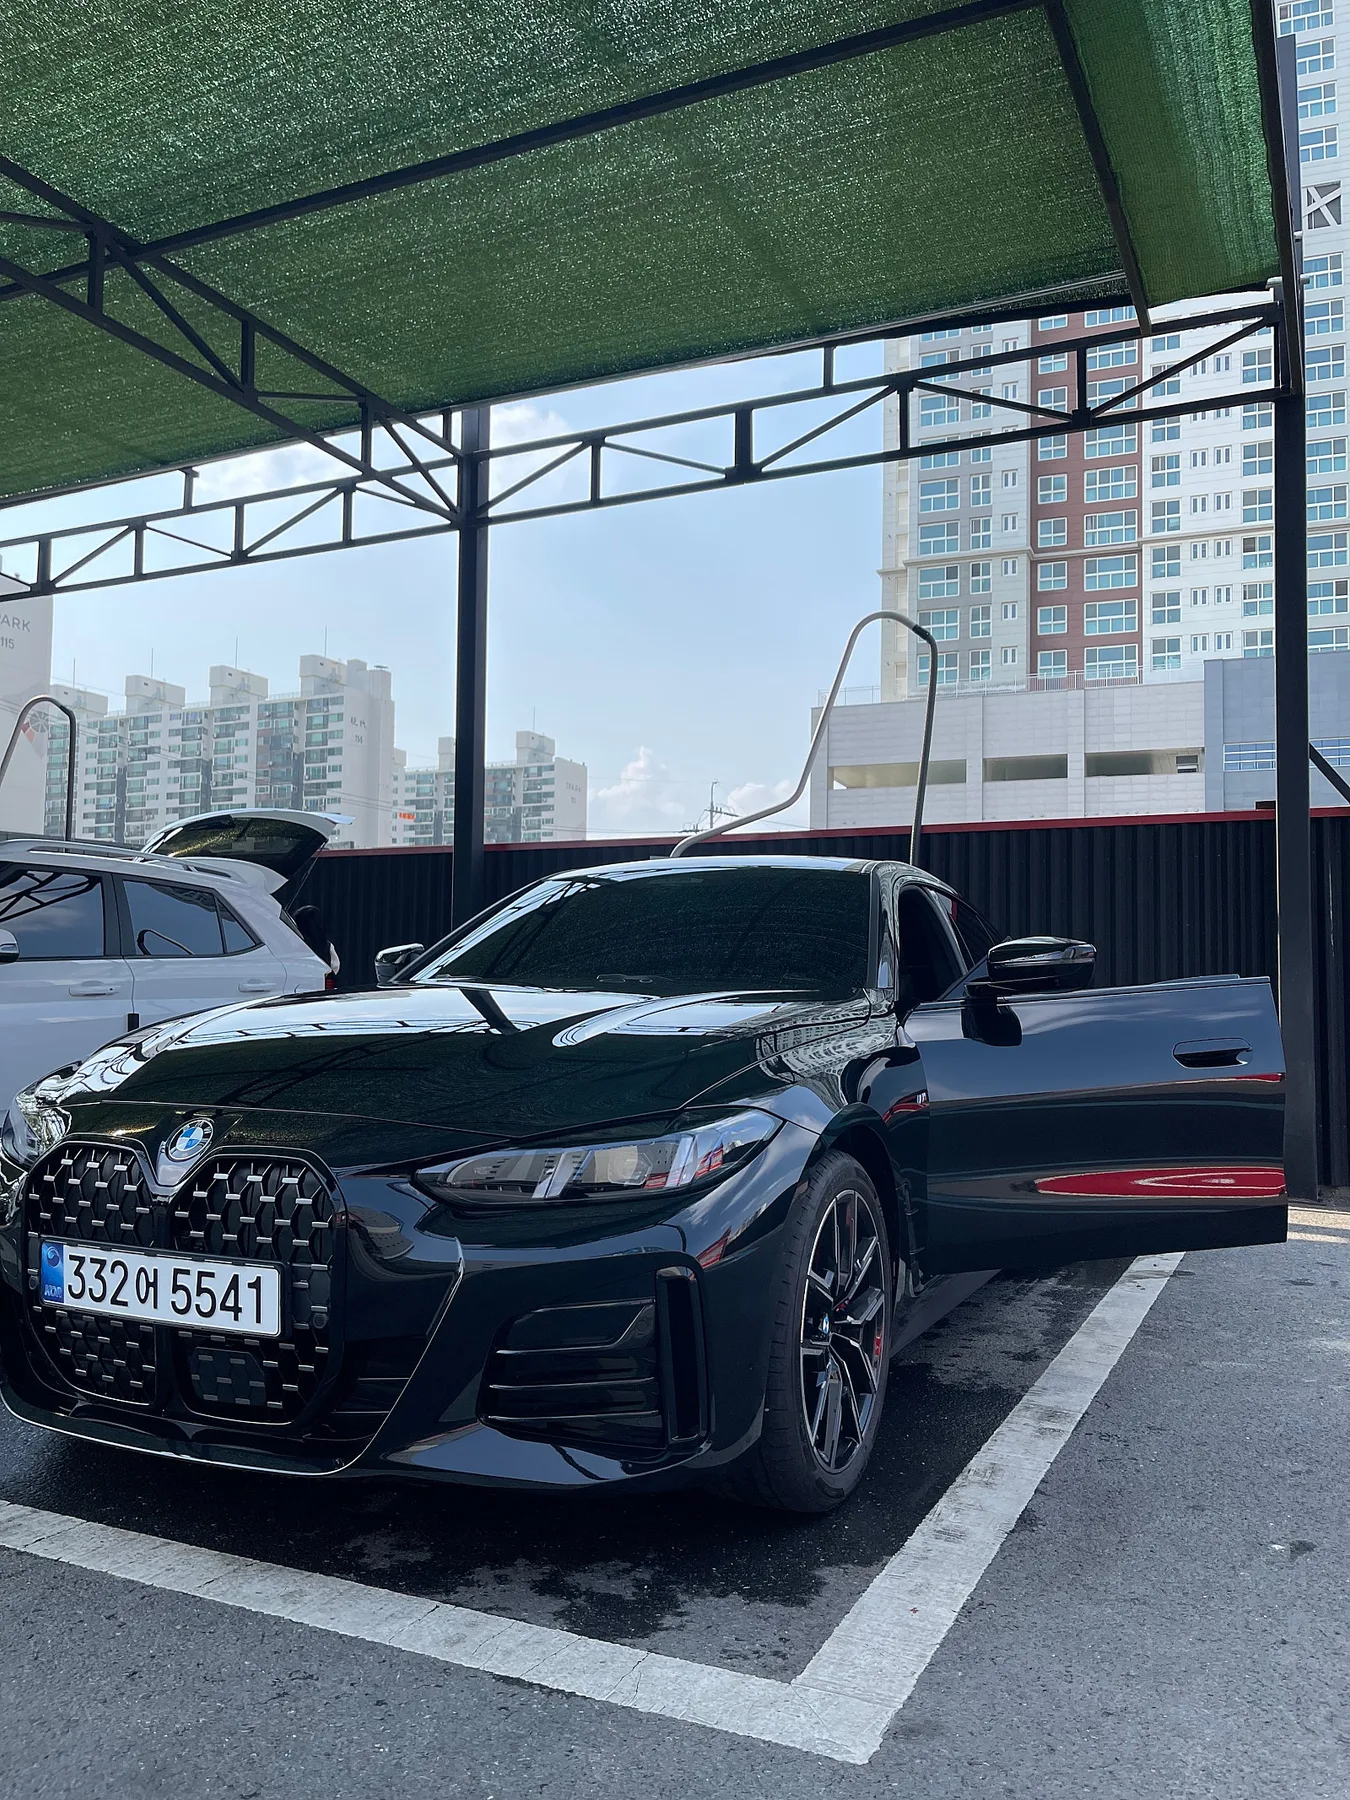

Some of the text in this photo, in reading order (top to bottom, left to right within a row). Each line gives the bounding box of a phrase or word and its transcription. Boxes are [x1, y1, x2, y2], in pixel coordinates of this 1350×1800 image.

[0, 613, 31, 633] ARK
[44, 1284, 63, 1298] KOR
[67, 1253, 263, 1324] 332어 5541
